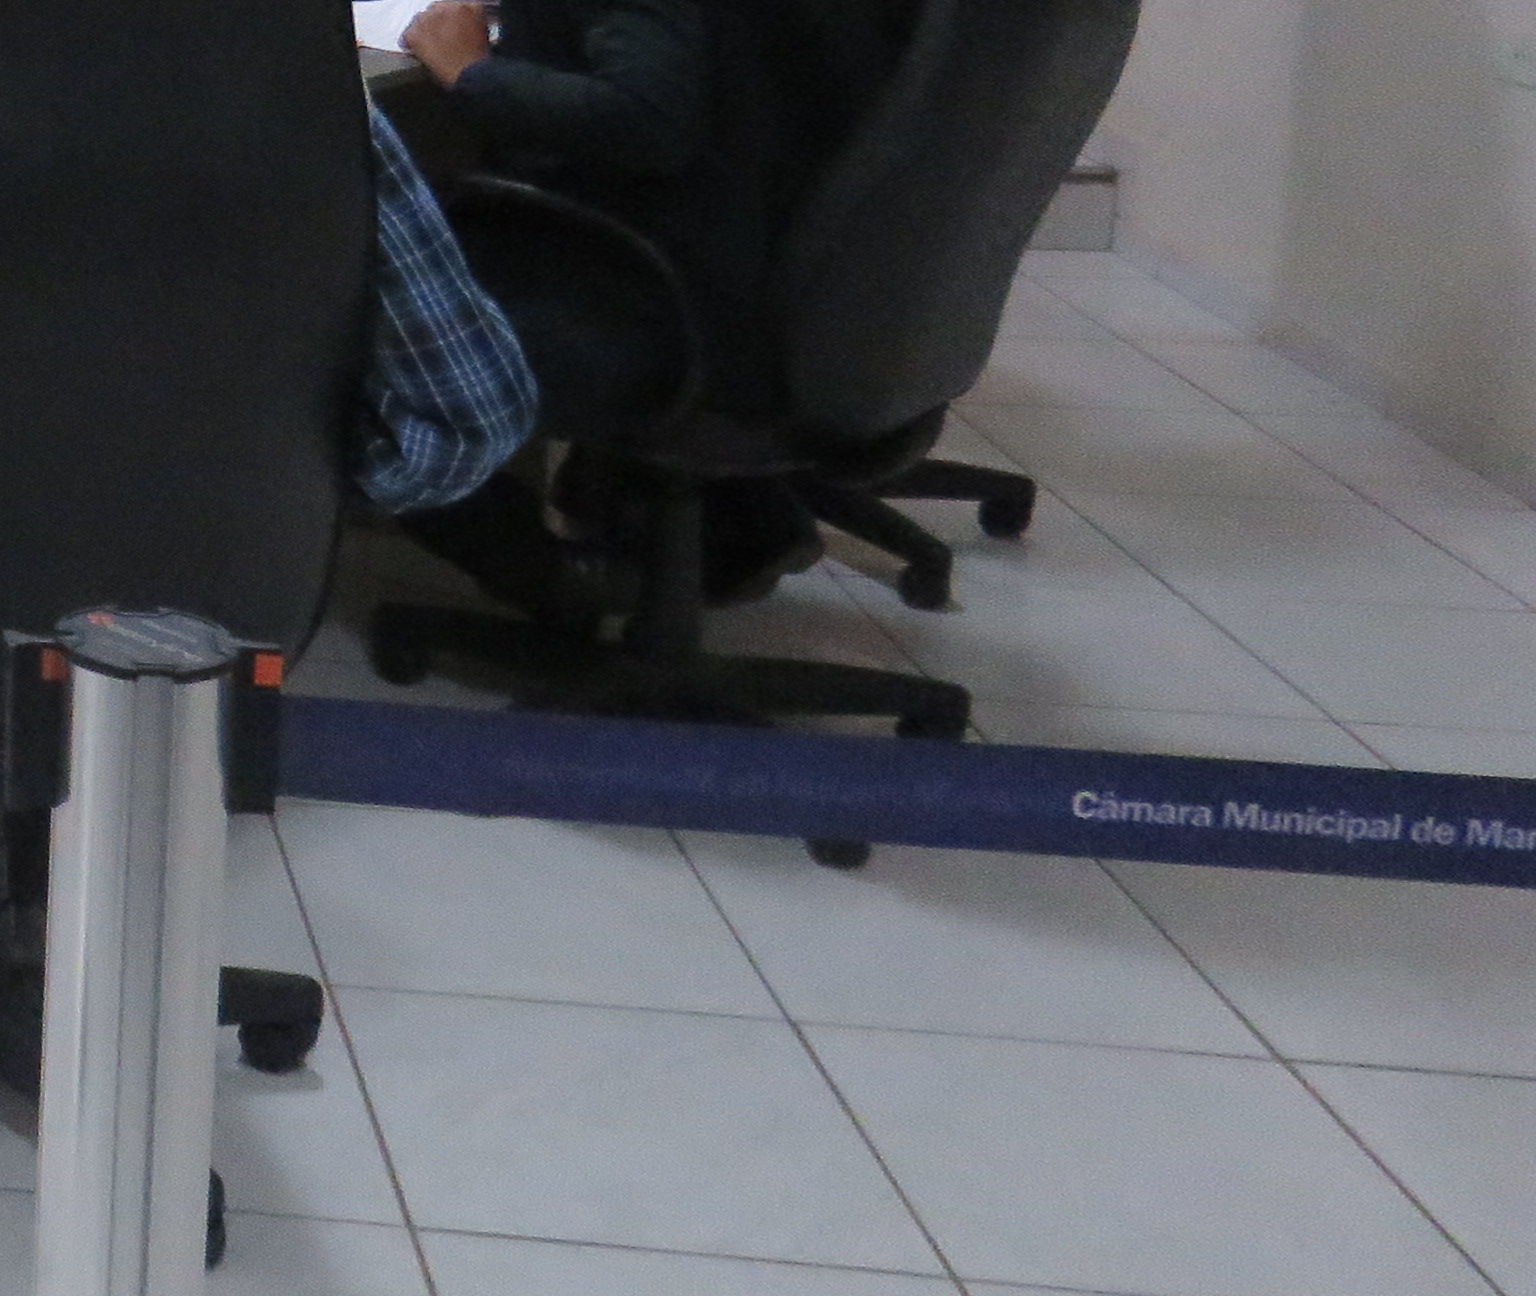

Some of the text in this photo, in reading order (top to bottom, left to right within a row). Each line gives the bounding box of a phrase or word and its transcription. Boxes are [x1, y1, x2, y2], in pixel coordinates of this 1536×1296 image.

[1071, 790, 1213, 828] Câmara
[1223, 801, 1402, 843] Municipal
[1410, 816, 1457, 847] de
